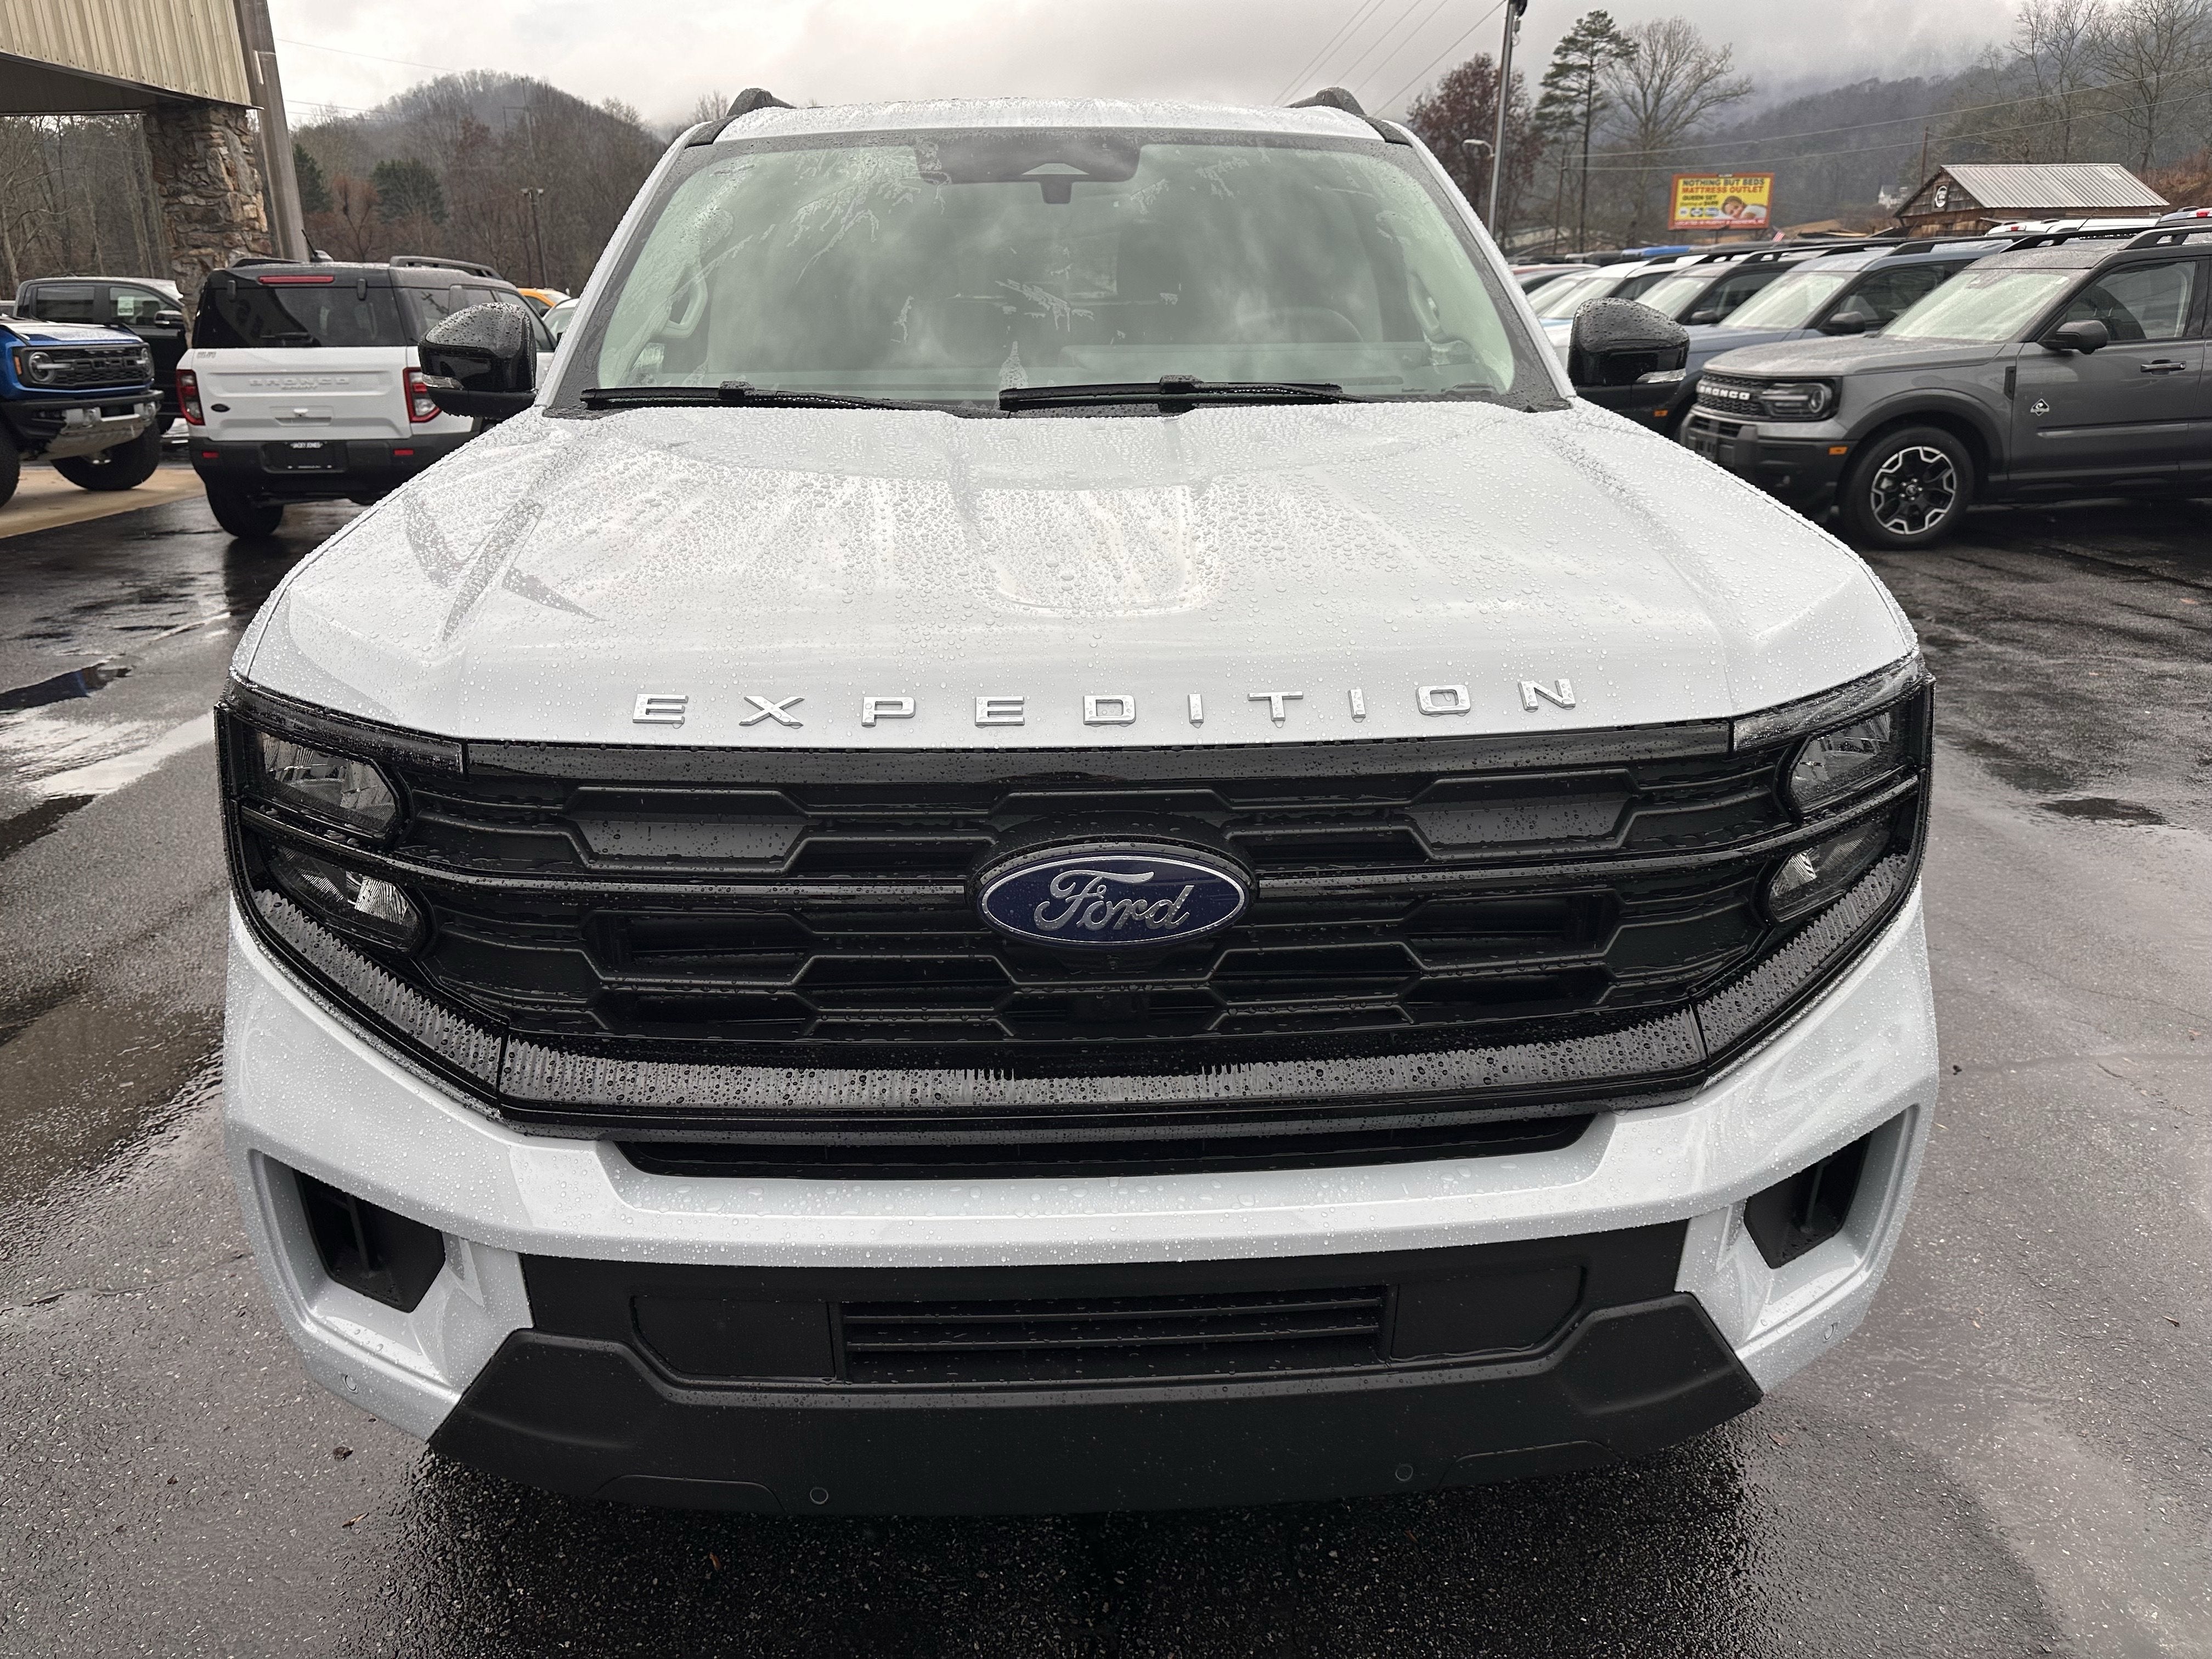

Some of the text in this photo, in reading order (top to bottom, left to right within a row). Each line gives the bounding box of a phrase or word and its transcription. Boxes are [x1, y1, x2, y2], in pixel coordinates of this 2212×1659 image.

[249, 377, 349, 387] BRONCO
[1699, 385, 1750, 400] BRONCO
[632, 678, 1577, 727] EXPEDITION
[1034, 869, 1195, 932] Ford
